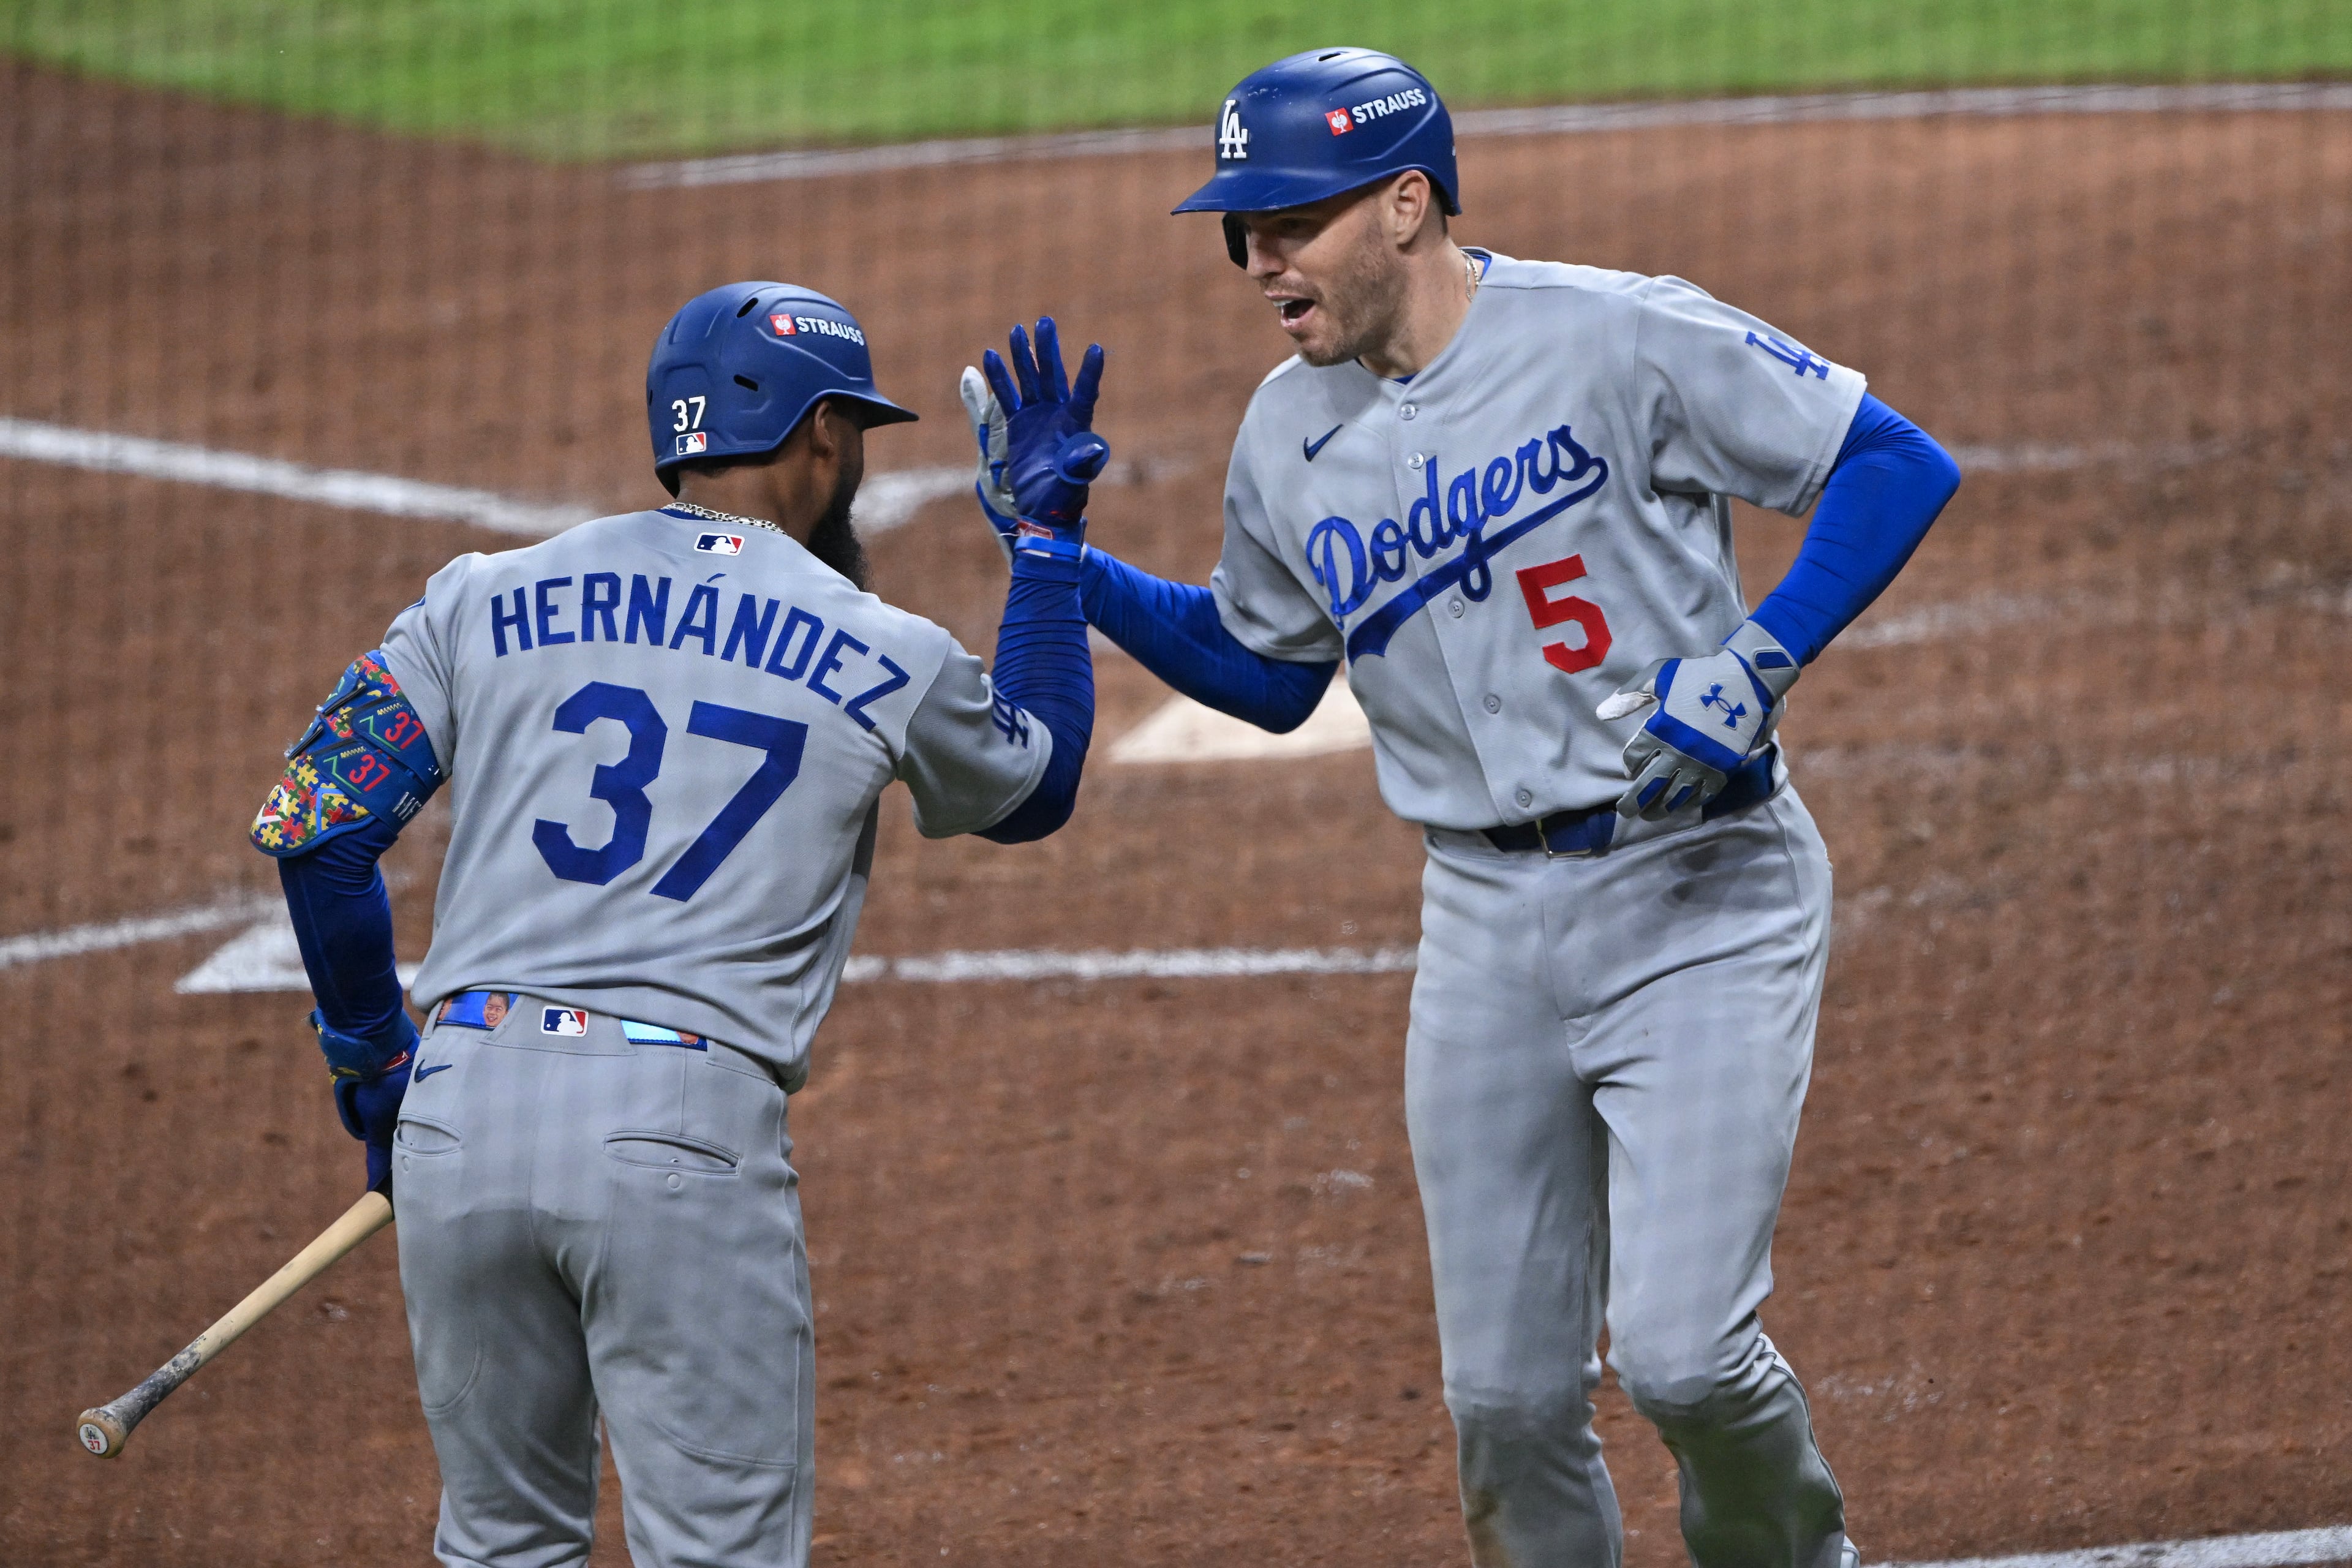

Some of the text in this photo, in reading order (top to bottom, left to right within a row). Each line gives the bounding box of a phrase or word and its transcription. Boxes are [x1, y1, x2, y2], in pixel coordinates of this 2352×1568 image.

[1352, 88, 1427, 124] STRAUSS
[1219, 99, 1248, 159] LA
[796, 316, 864, 346] STRAUSS
[672, 396, 706, 432] 37
[1306, 424, 1608, 631] Dodgers
[1516, 554, 1612, 674] 5
[491, 571, 911, 731] HERNÁNDEZ
[385, 711, 424, 749] 37
[349, 754, 391, 791] 37
[532, 681, 809, 902] 37
[88, 1440, 100, 1450] 37
